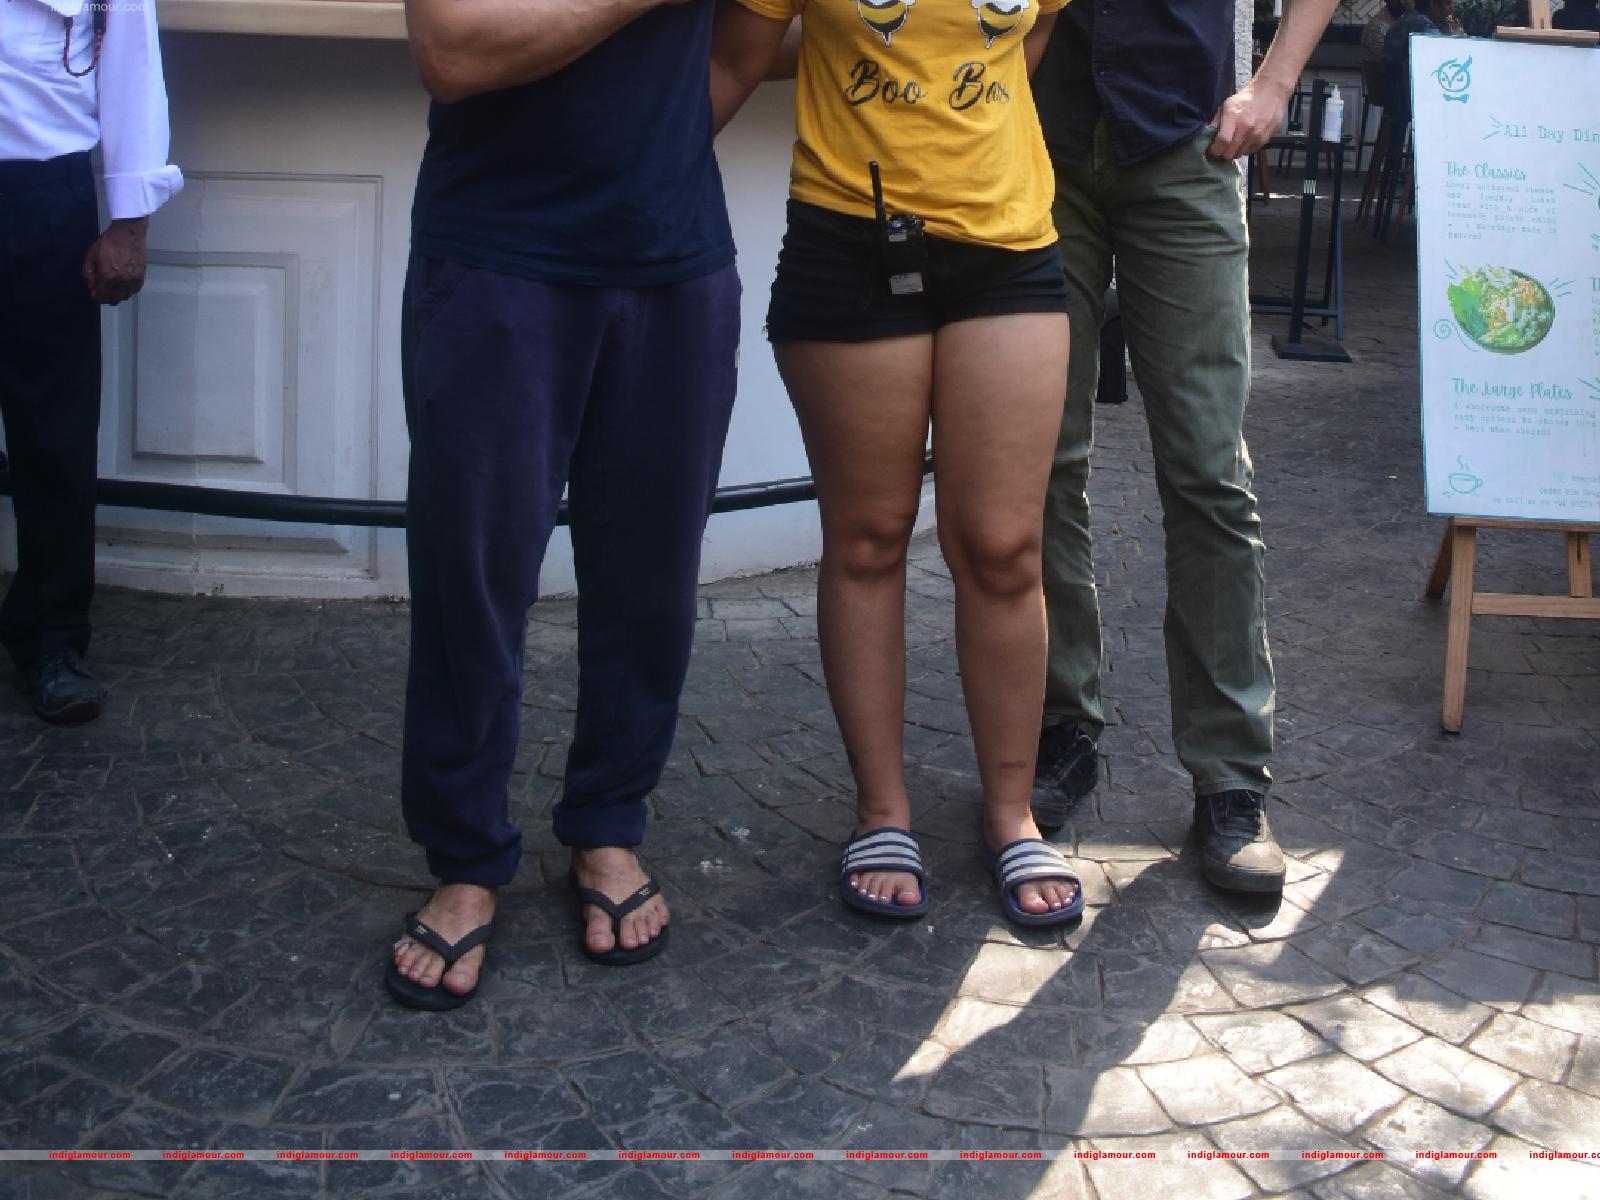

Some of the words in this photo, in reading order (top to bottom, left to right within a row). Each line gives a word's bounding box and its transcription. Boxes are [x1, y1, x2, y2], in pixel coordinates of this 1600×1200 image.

[845, 60, 926, 107] Boo
[1504, 124, 1528, 138] All
[1537, 125, 1564, 143] Day
[1440, 161, 1469, 177] The
[1474, 162, 1526, 181] Classics
[1452, 377, 1478, 395] The
[1482, 381, 1523, 400] Large
[1529, 381, 1573, 400] Plates
